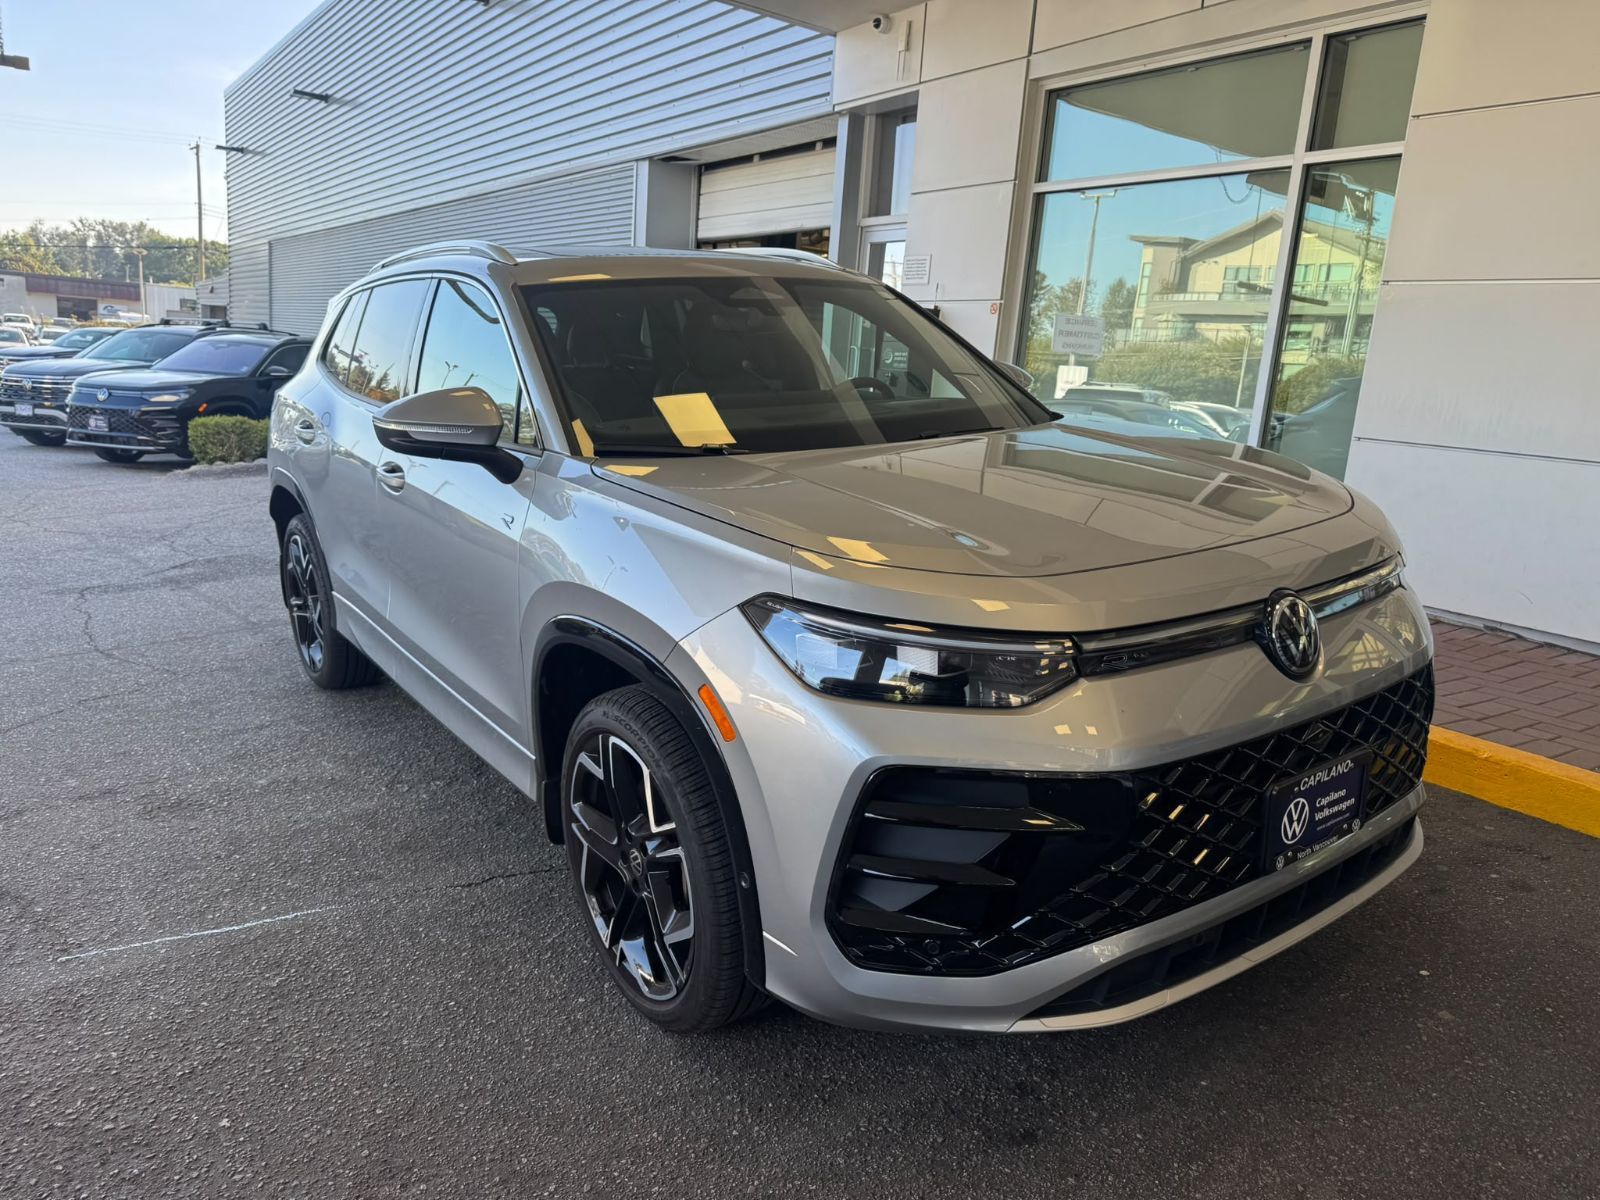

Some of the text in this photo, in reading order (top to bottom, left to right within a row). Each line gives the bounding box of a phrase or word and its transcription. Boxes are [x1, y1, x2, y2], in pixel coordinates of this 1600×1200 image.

[500, 512, 515, 530] R
[1300, 759, 1352, 791] CAPILANO
[1316, 788, 1347, 807] Capilano
[1314, 797, 1355, 821] Volkswagen
[1281, 797, 1310, 845] VW
[1297, 848, 1311, 860] North
